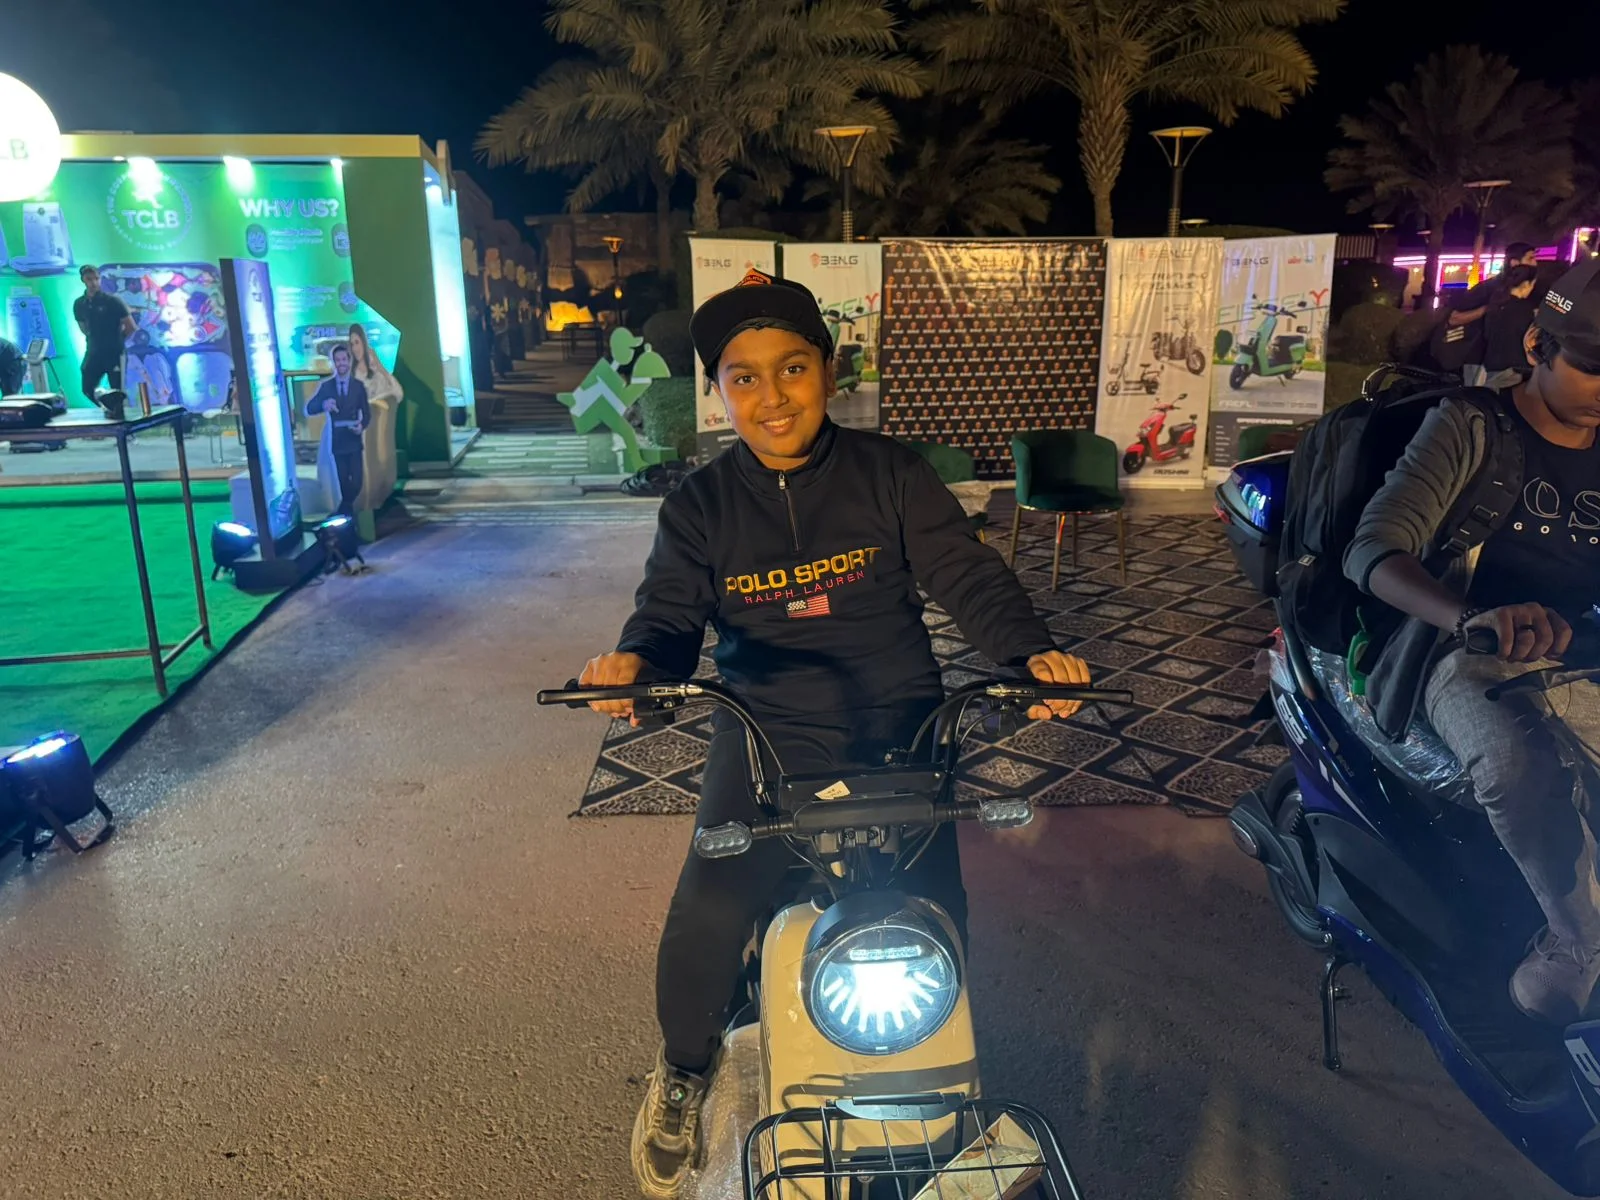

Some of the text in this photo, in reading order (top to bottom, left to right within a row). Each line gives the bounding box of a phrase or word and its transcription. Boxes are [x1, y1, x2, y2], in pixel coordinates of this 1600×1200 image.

[0, 138, 29, 160] B
[121, 209, 180, 229] TCLB
[239, 198, 340, 218] WHY US?
[724, 547, 882, 596] POLO SPORT
[744, 570, 865, 605] RALPH LAUREN
